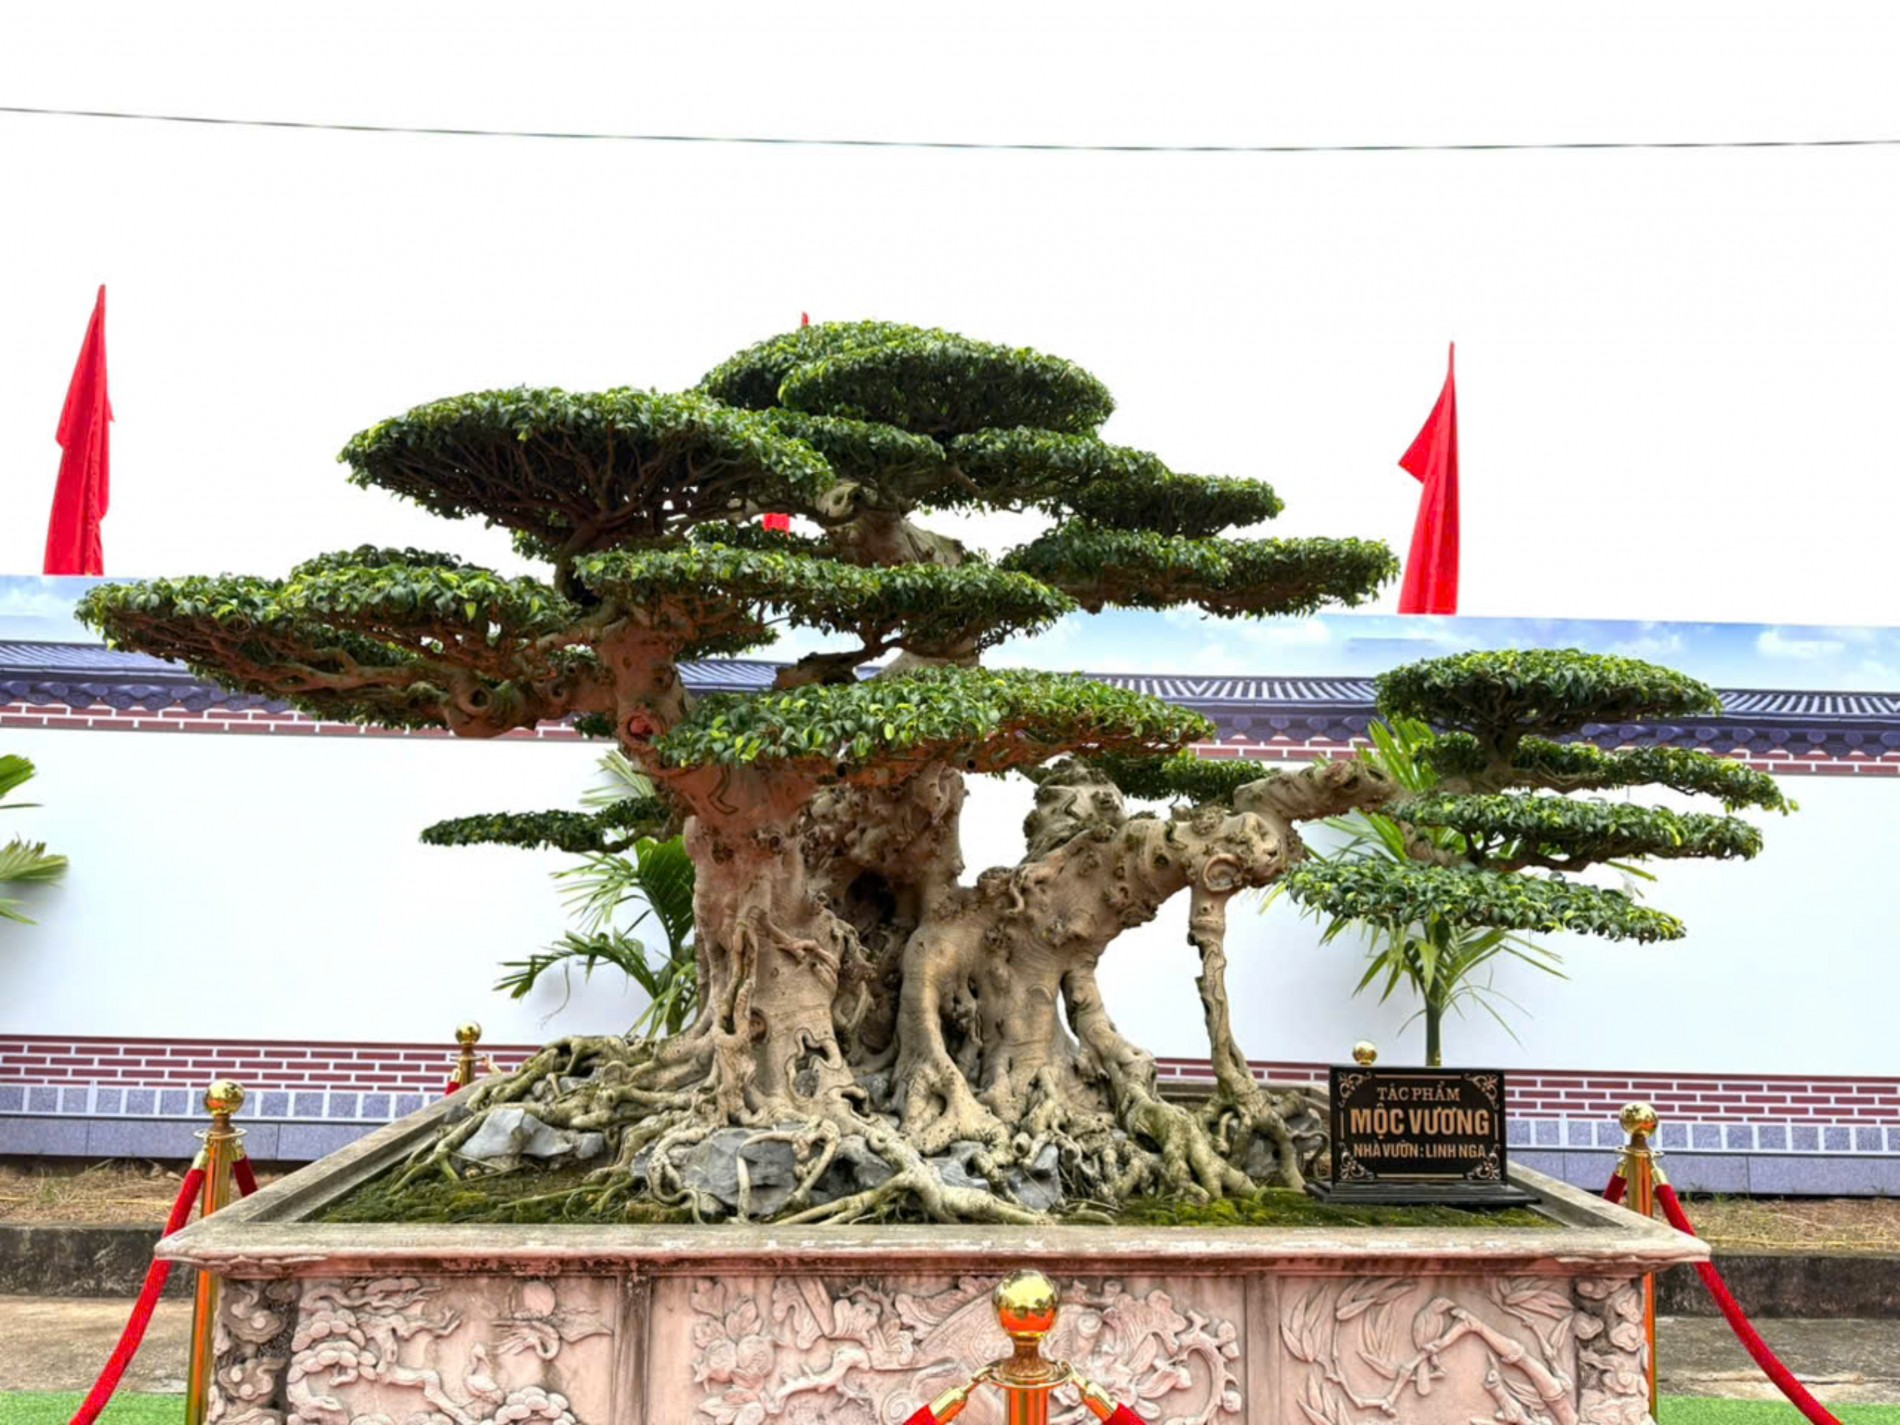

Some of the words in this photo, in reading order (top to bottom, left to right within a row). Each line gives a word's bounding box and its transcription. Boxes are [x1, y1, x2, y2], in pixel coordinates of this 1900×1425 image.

[1350, 1102, 1405, 1139] MỘC
[1408, 1106, 1490, 1136] VƯƠNG
[1353, 1140, 1381, 1158] NHÀ
[1425, 1143, 1457, 1158] LINH
[1458, 1144, 1486, 1158] NGA
